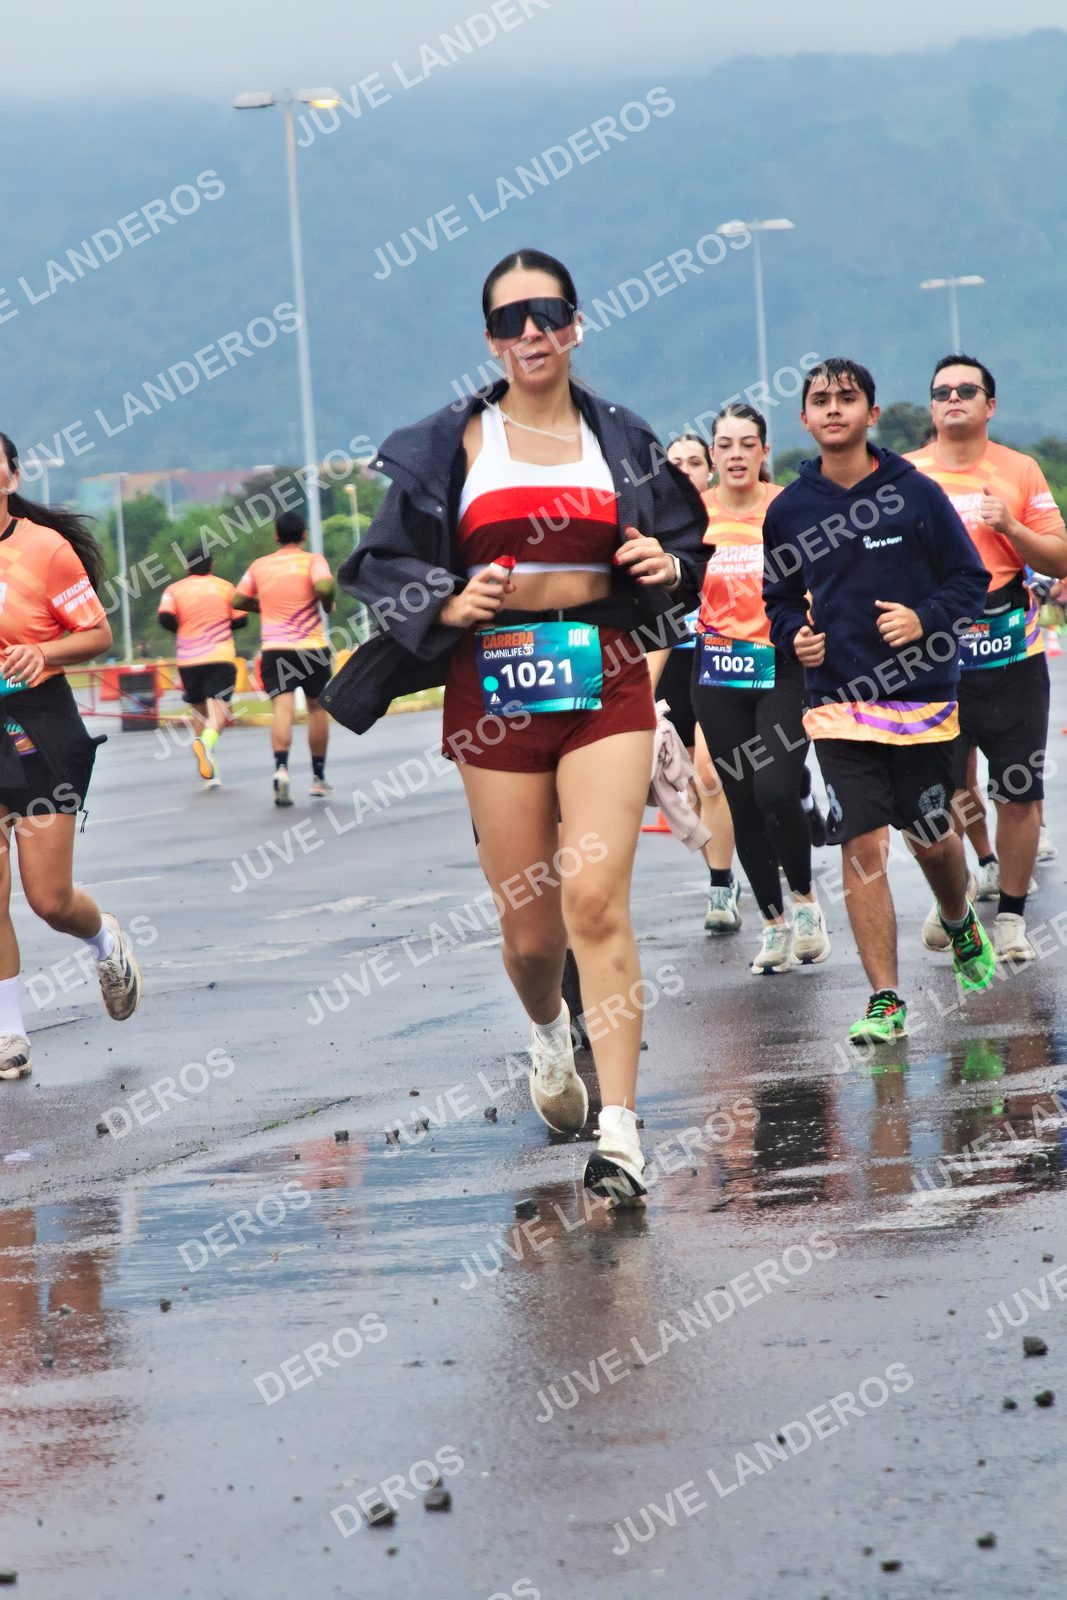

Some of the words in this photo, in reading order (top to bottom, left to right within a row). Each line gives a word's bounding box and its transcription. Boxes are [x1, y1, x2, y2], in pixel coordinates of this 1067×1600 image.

[483, 631, 534, 649] CARRERA
[568, 628, 590, 647] 10K
[968, 635, 1012, 656] 1003
[501, 658, 573, 689] 1021
[712, 655, 755, 673] 1002
